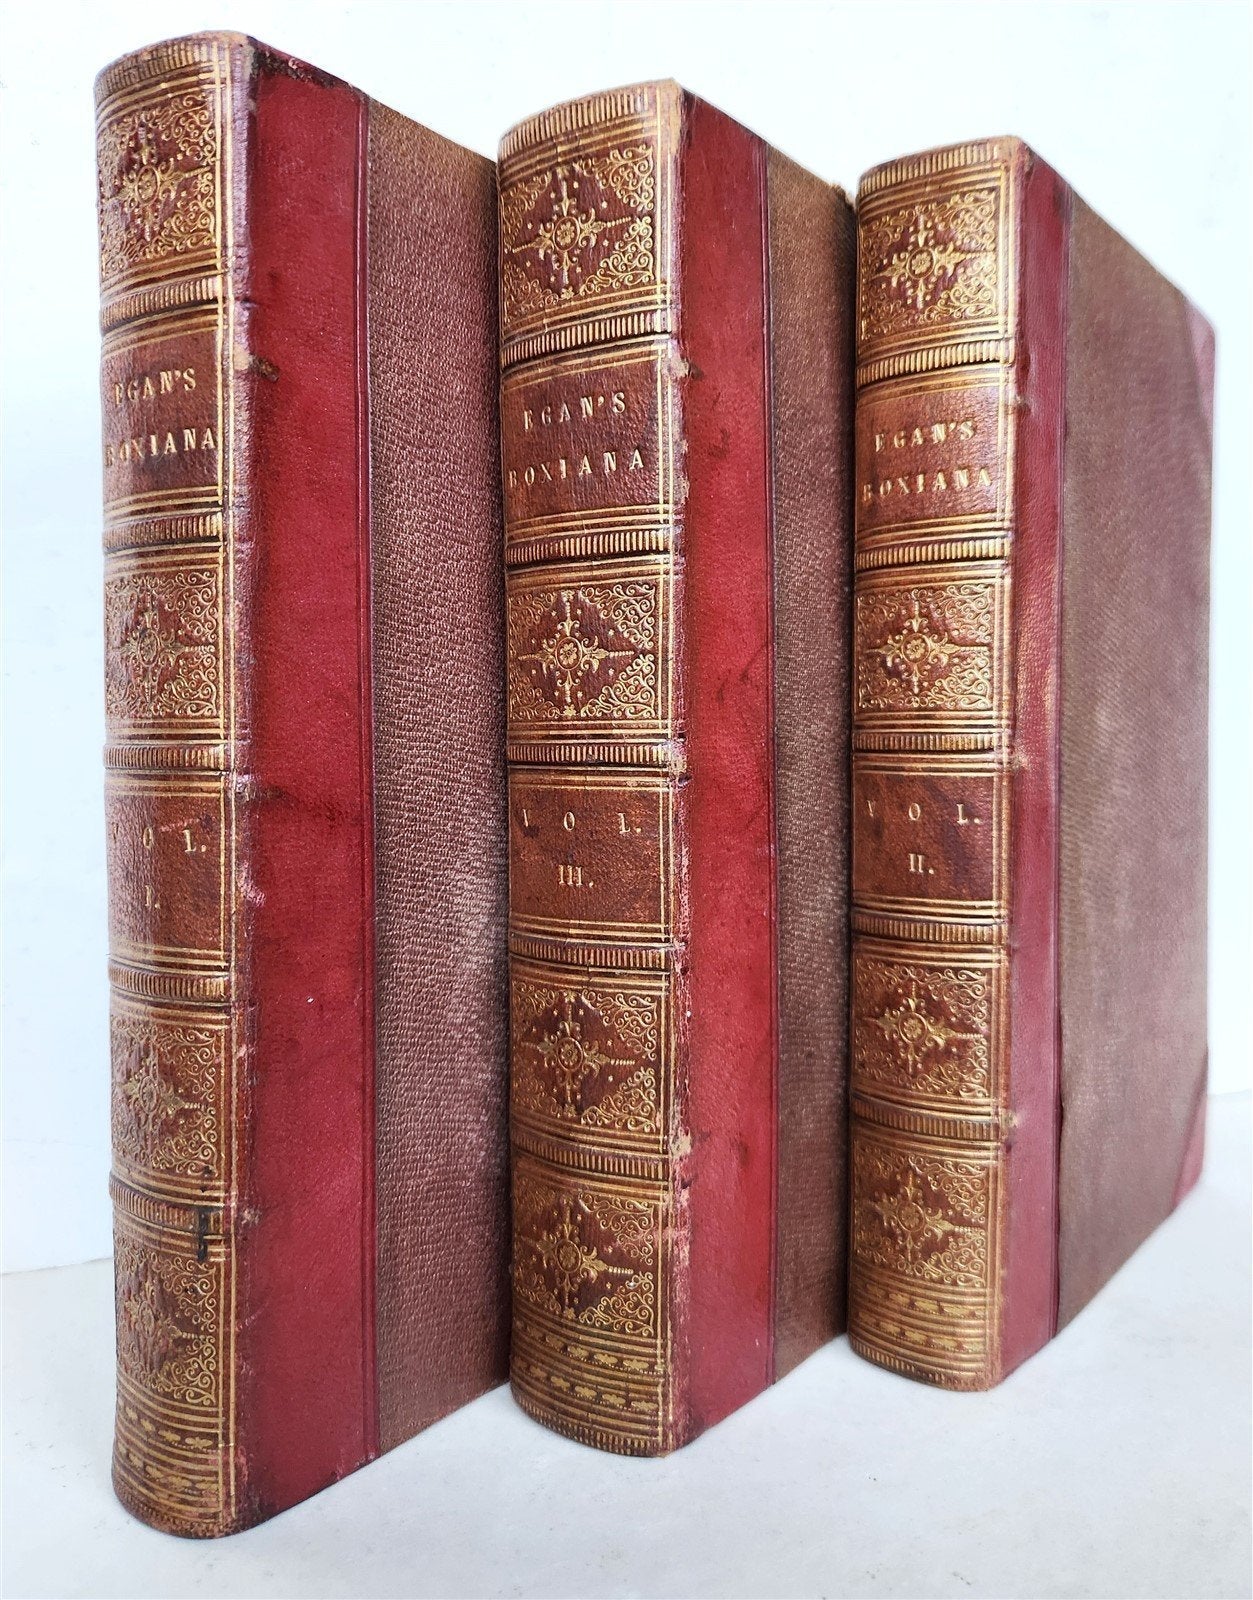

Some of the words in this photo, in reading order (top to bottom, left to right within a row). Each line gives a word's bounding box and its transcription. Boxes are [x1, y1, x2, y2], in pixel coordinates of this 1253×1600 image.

[114, 368, 197, 405] EGAN'S
[523, 391, 626, 431] EGAN'S
[105, 427, 216, 468] BOXIANA
[874, 420, 975, 452] EGAN'S
[508, 449, 644, 488] BOXIANA
[863, 467, 992, 502] BOXIANA
[558, 864, 594, 888] III.
[908, 853, 935, 875] II.
